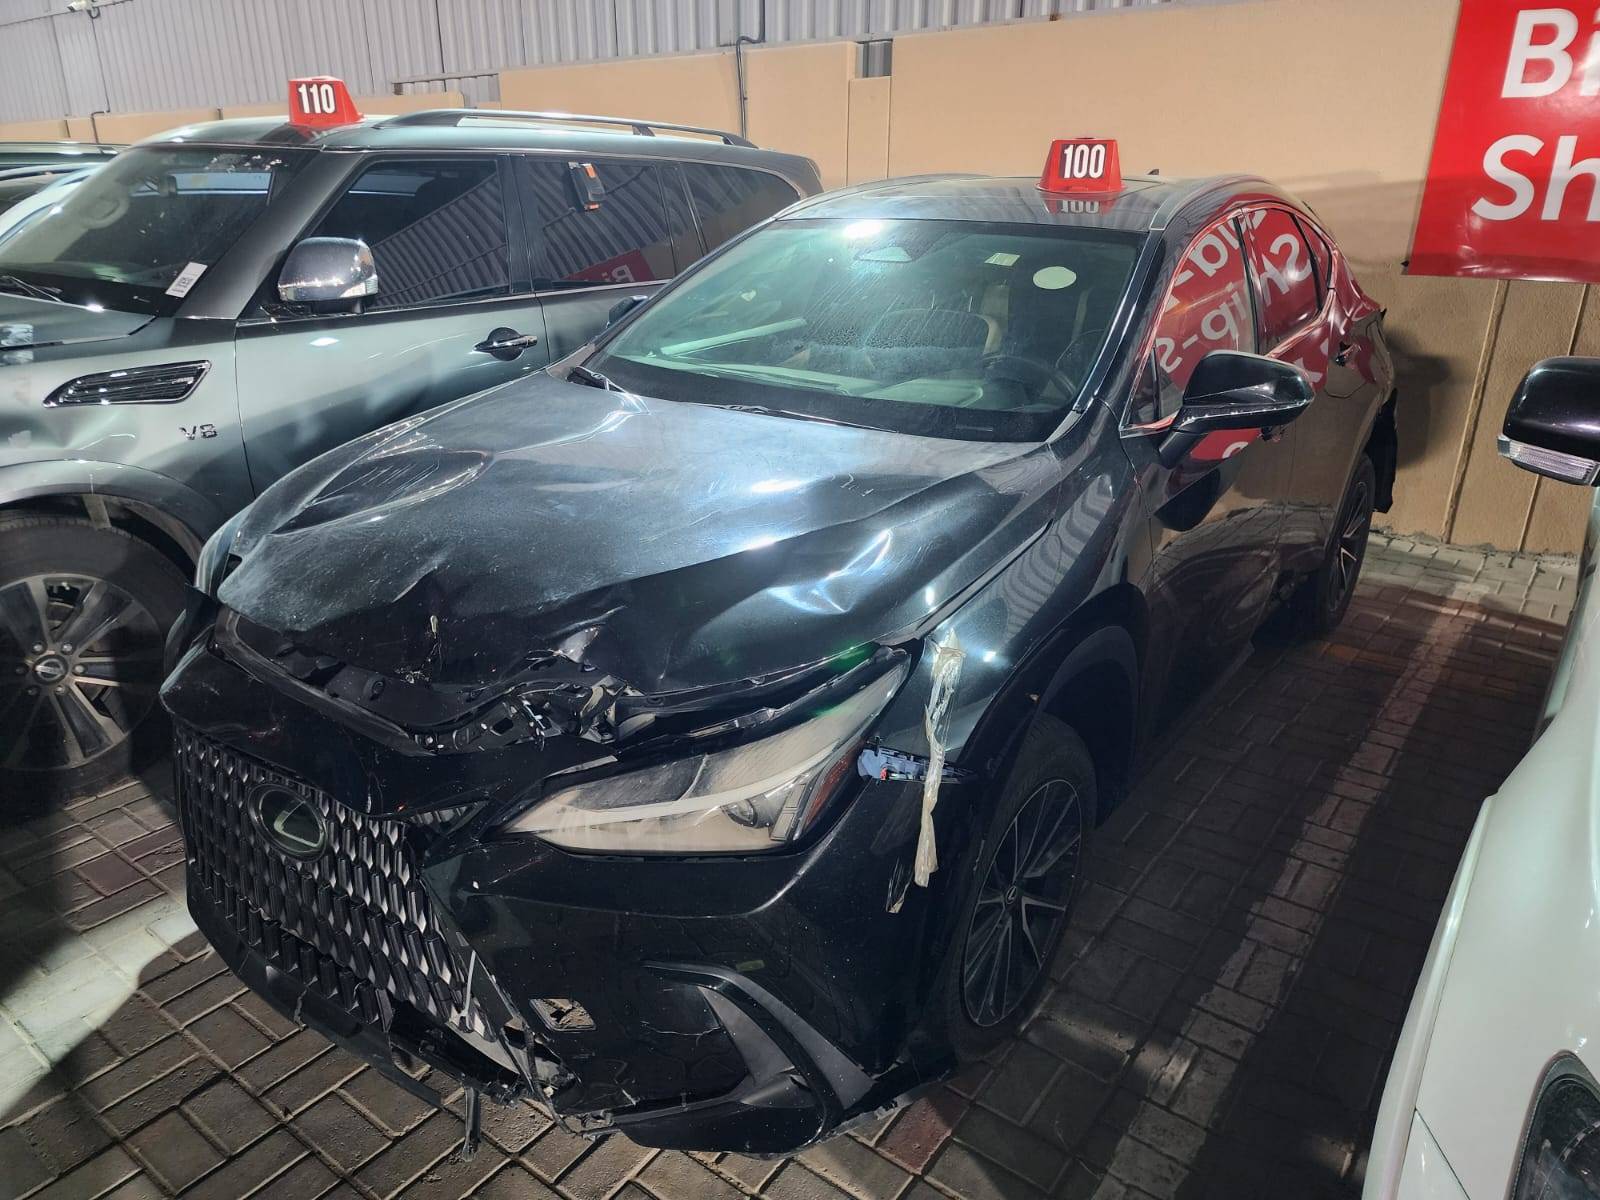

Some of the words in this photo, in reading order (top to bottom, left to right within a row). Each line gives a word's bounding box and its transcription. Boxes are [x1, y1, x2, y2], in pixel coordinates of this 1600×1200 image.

[298, 83, 335, 114] 110
[1063, 144, 1106, 178] 100
[1471, 134, 1600, 222] Sh
[179, 423, 218, 440] V8
